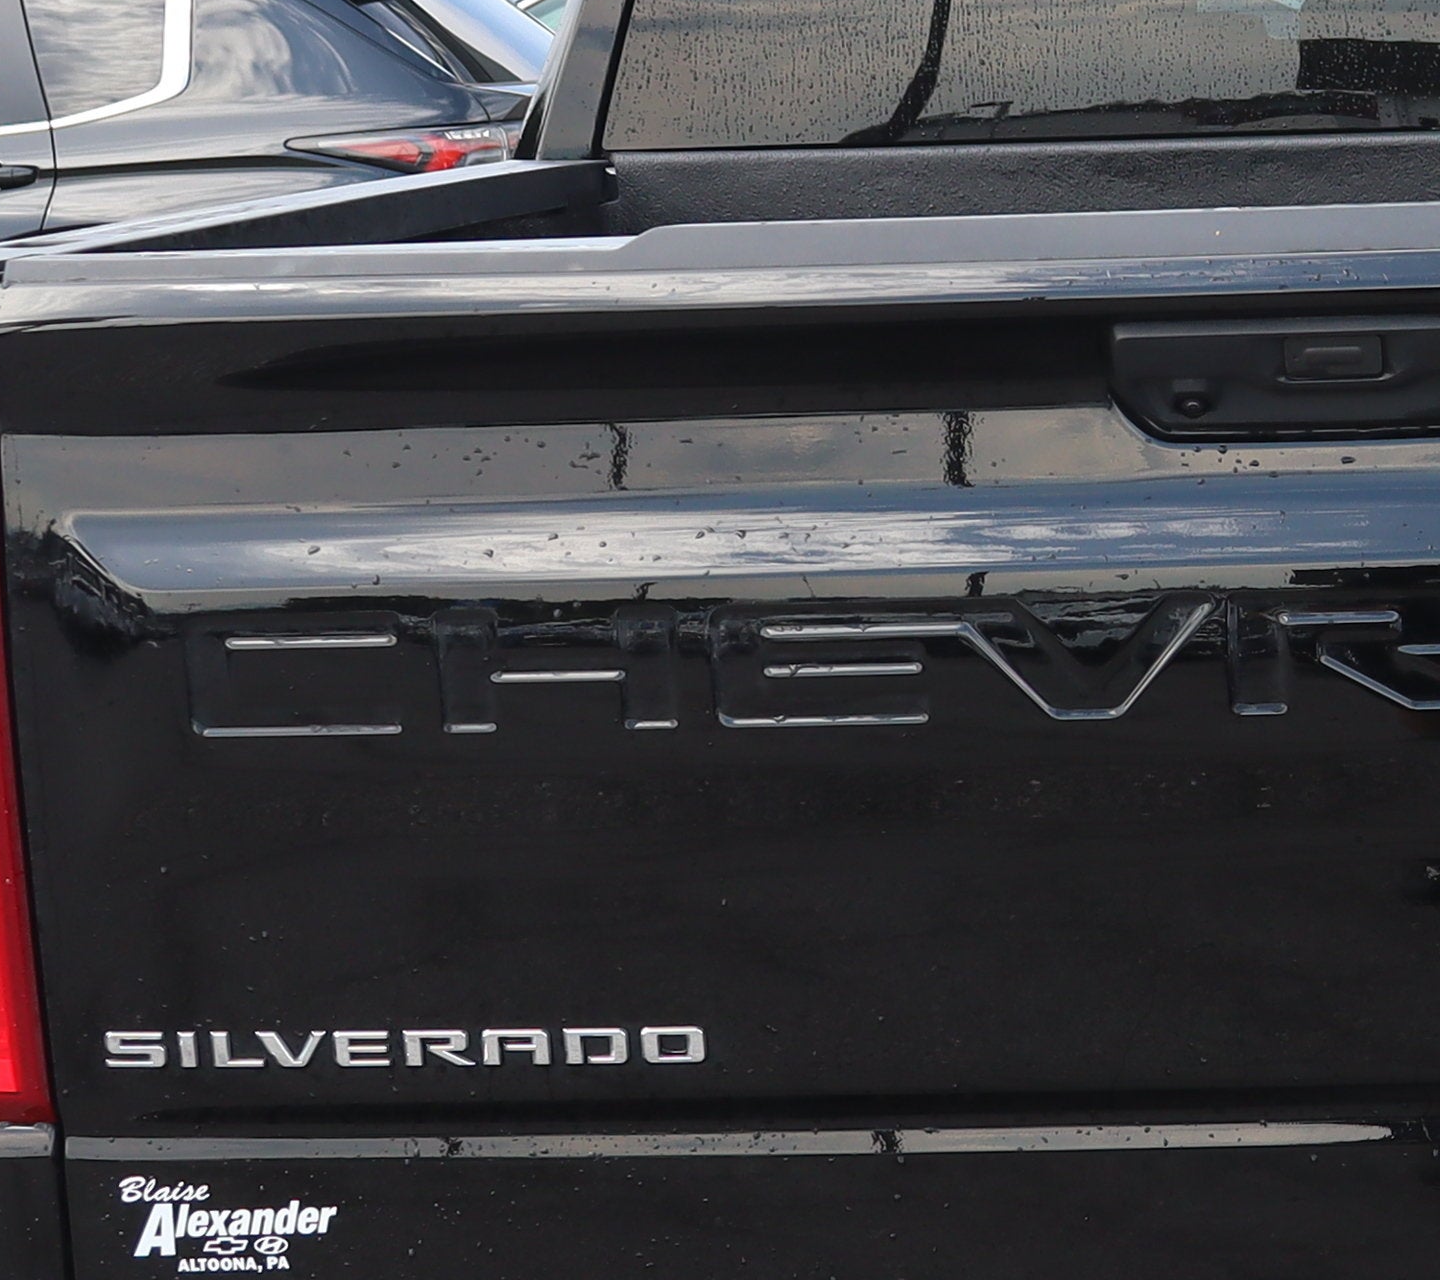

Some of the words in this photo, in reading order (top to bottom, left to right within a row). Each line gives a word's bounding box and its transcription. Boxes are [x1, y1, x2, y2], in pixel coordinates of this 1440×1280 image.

[104, 1025, 710, 1068] SILVERADO
[118, 1175, 211, 1204] Blaise
[133, 1199, 338, 1258] Alexander
[177, 1256, 264, 1273] ALTOONA,
[266, 1254, 290, 1271] PA
